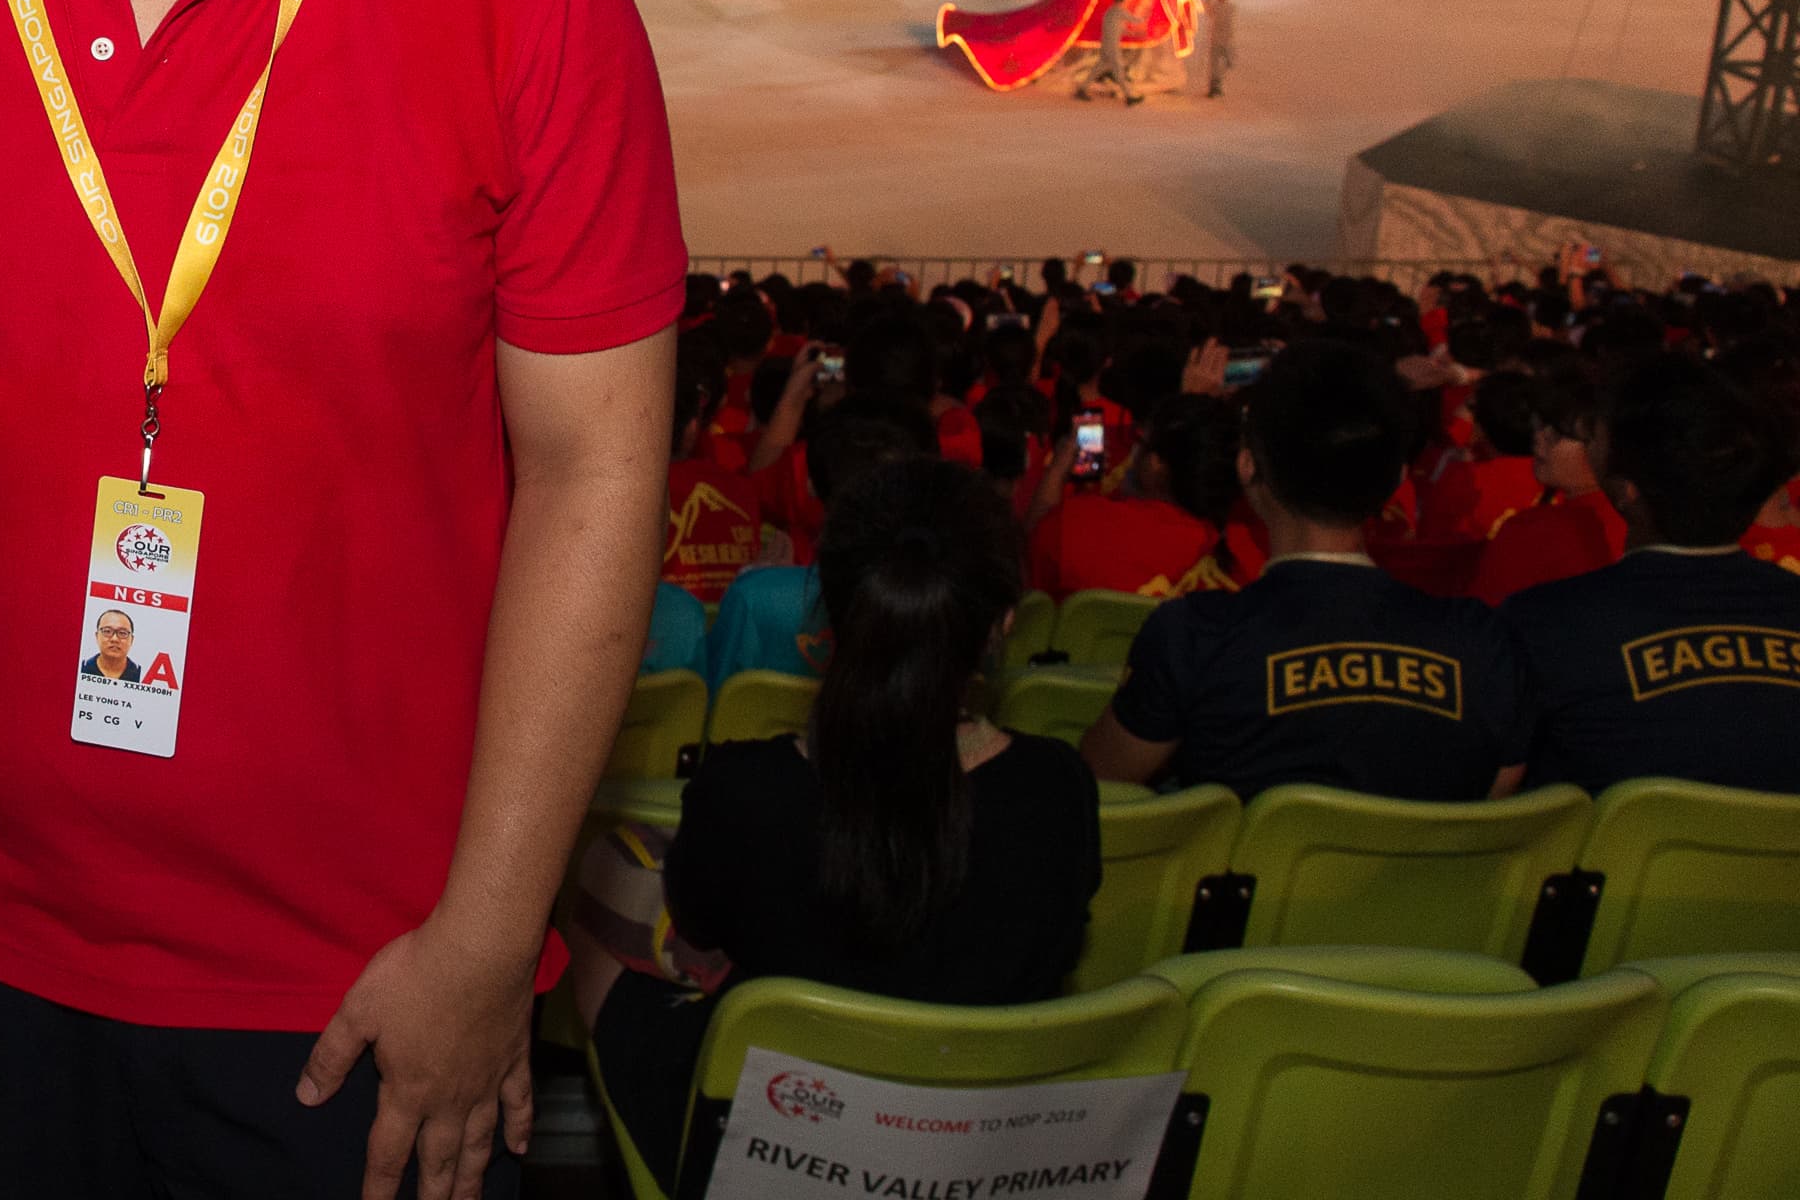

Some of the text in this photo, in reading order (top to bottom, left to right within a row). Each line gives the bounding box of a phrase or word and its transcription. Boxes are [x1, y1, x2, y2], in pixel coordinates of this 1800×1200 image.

[79, 170, 119, 244] OUR
[195, 164, 239, 246] 2019
[153, 506, 183, 523] PR2
[134, 541, 170, 555] OUR
[141, 652, 180, 690] A
[1283, 652, 1447, 699] EAGLES
[78, 693, 133, 709] LEE YONG TA
[79, 710, 143, 729] PS CG V
[874, 1108, 1087, 1134] WELCOME TO NDP 2019
[747, 1137, 1132, 1200] RIVER VALLEY PRIMARY
